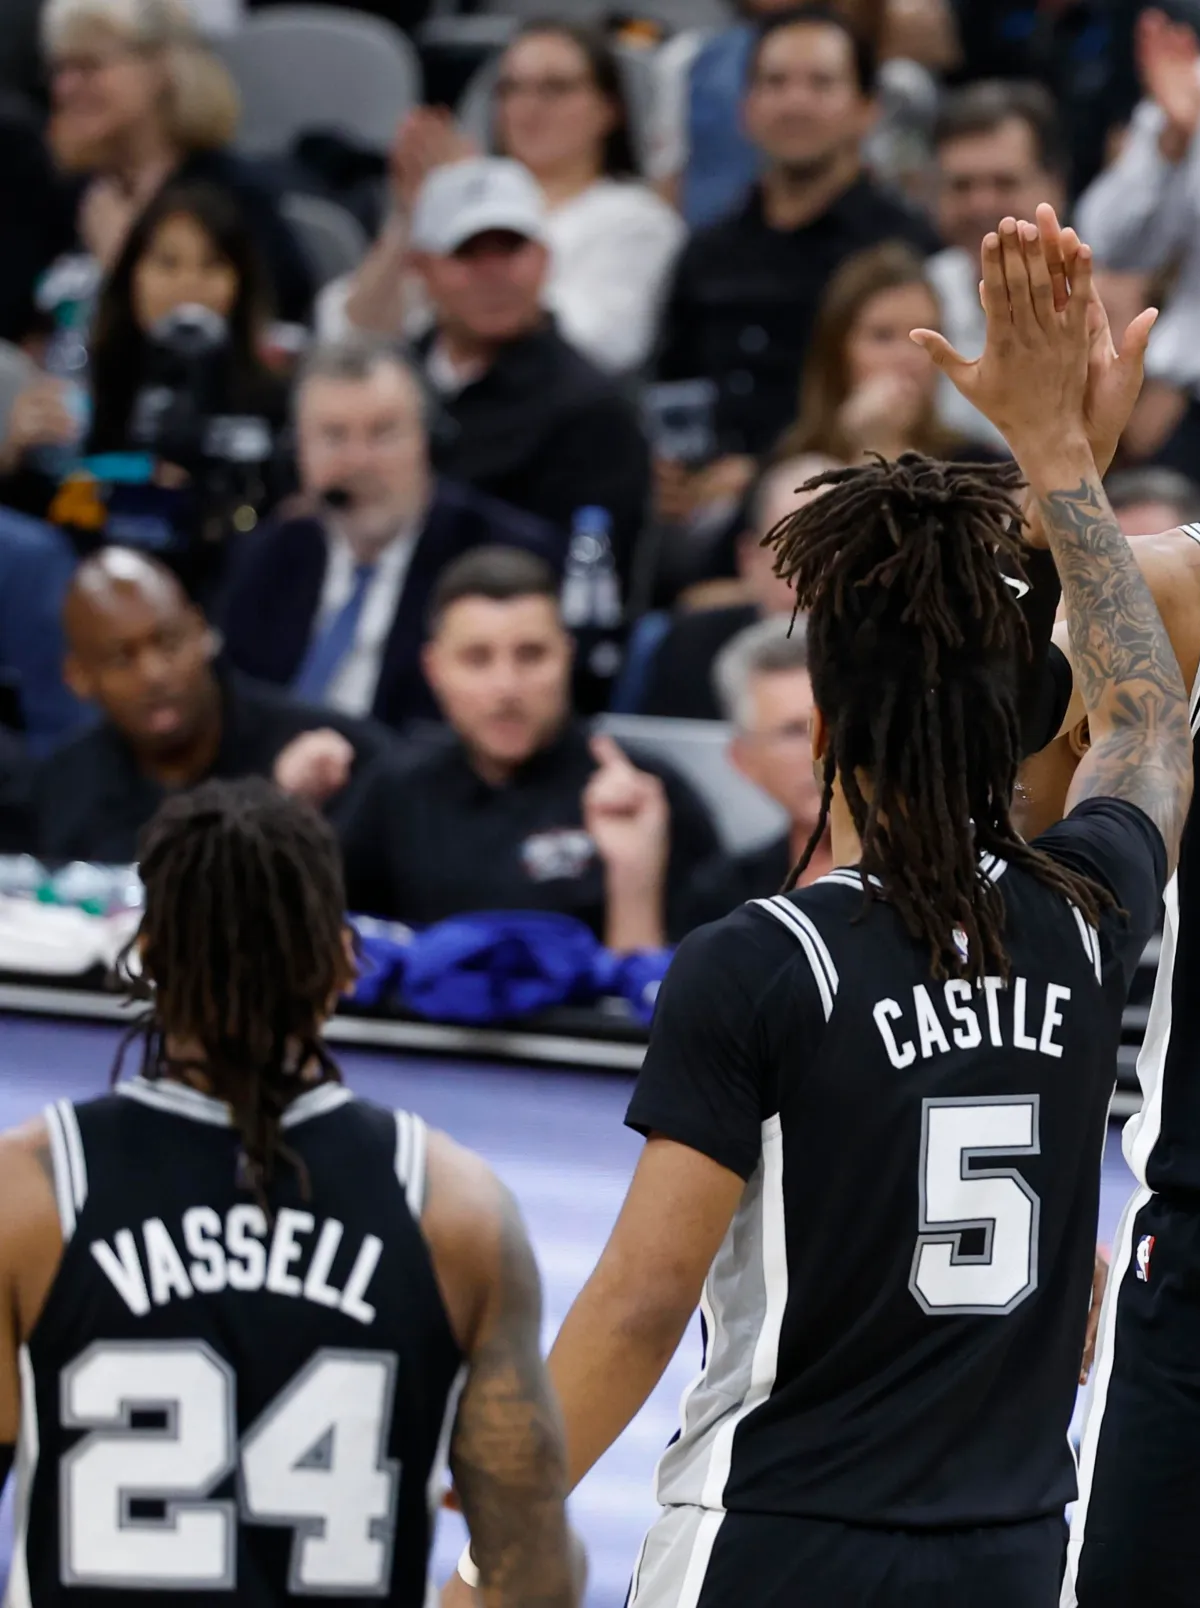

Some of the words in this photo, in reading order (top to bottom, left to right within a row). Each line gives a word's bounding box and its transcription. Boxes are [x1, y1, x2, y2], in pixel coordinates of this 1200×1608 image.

[873, 976, 1071, 1069] CASTLE
[90, 1204, 383, 1325] VASSELL
[908, 1094, 1041, 1315] 5
[59, 1339, 402, 1597] 24
